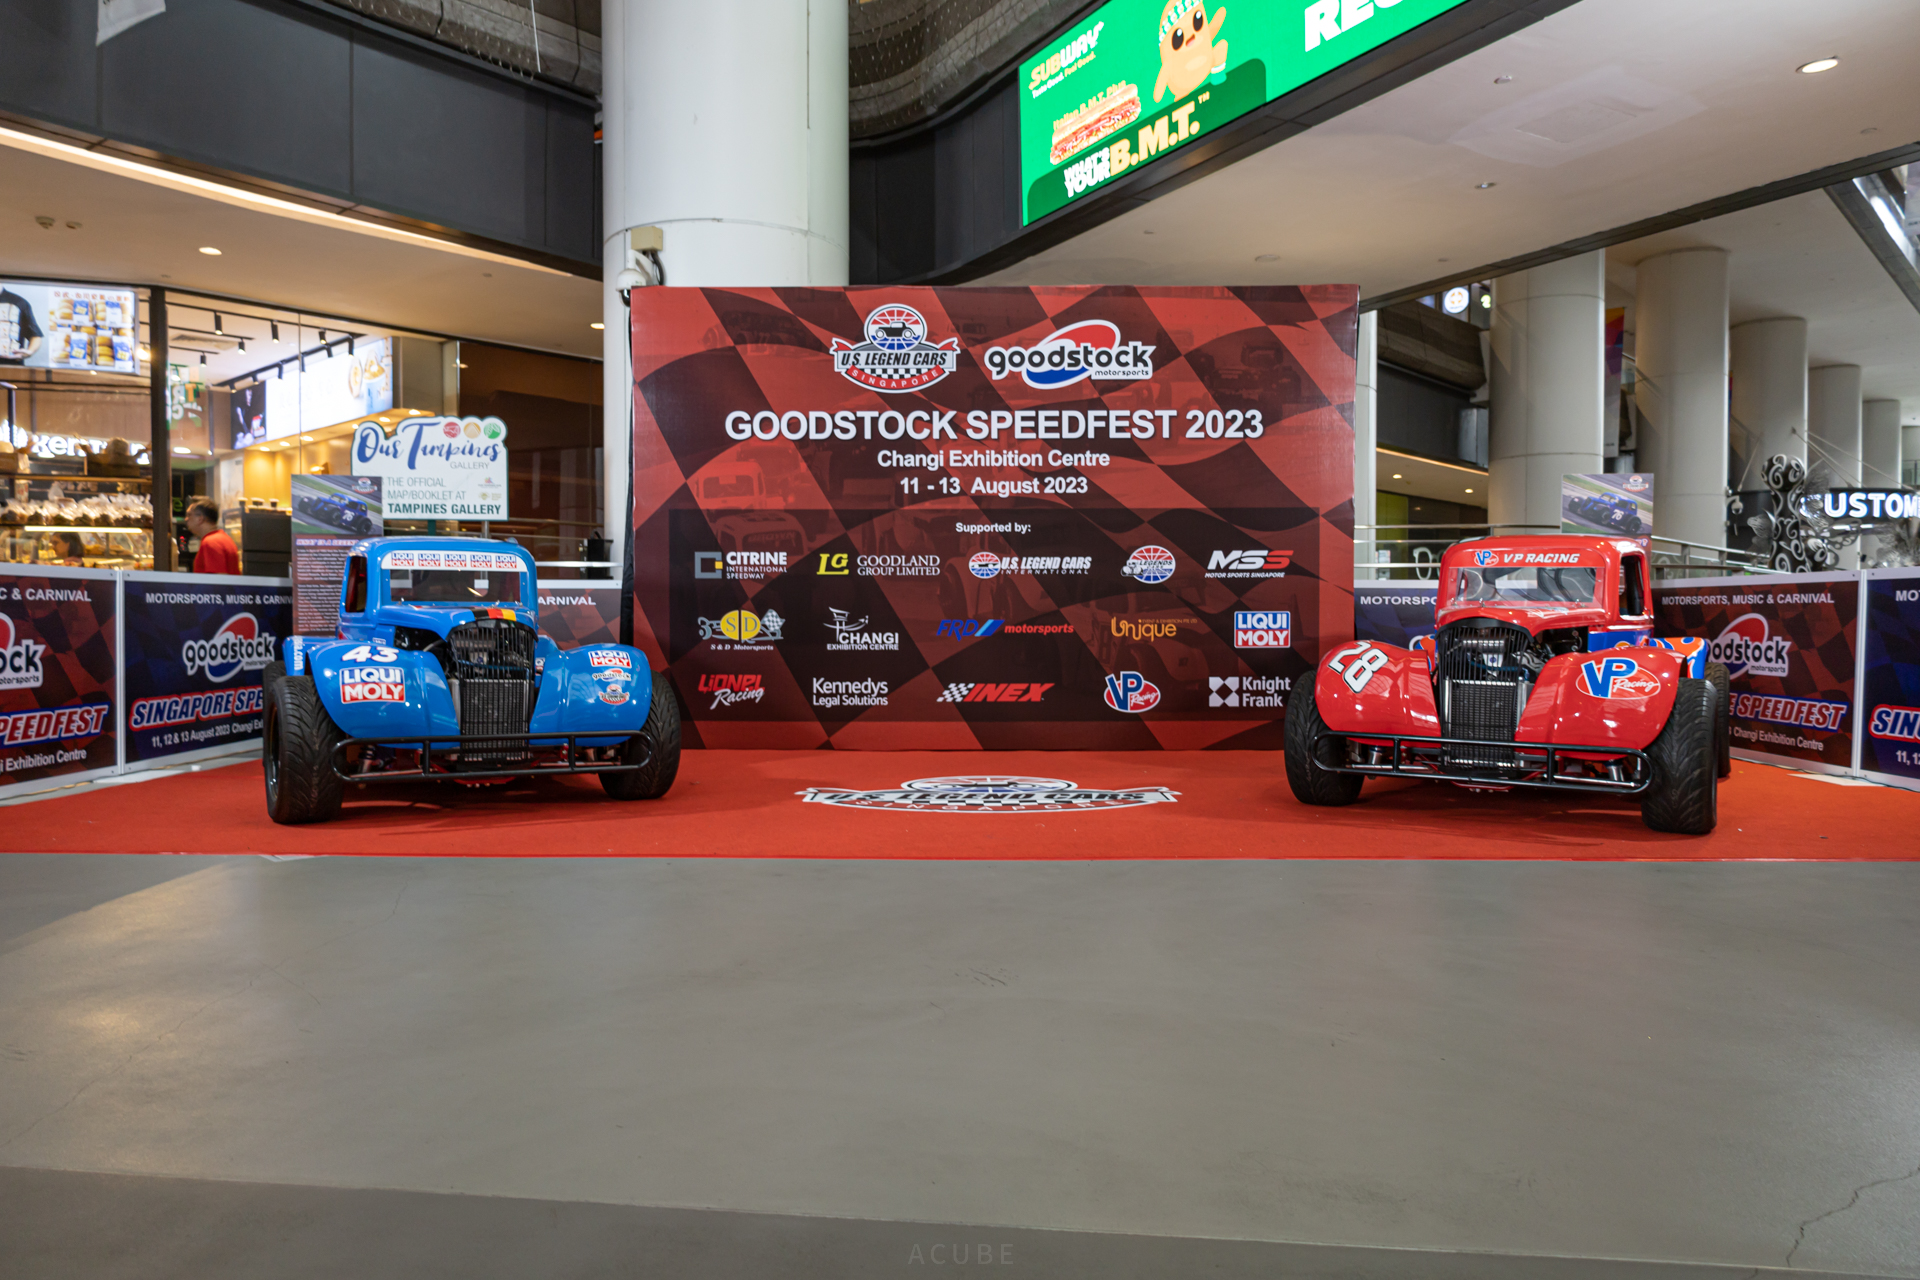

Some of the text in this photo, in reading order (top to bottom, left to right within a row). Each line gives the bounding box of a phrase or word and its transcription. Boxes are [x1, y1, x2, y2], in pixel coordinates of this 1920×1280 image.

[1305, 0, 1401, 52] RE
[1029, 21, 1104, 90] SUBWAY
[1064, 160, 1111, 198] YOUR
[1110, 101, 1200, 176] B.M.T.
[841, 352, 947, 366] U.S. LEGEND CARS
[988, 345, 1149, 376] goodstock
[851, 368, 940, 388] SINGAPORE
[1095, 370, 1149, 378] motorsports
[725, 410, 1264, 440] GOODSTOCK SPEEDFEST 2023
[450, 461, 490, 470] GALLERY
[877, 449, 1110, 472] Changi Exhibition Centre
[387, 477, 404, 487] THE
[407, 477, 446, 487] OFFICIAL
[900, 477, 1088, 498] 11 13 August 2023
[387, 490, 466, 500] MAP/BOOKLET AT
[387, 503, 502, 515] TAMPINES GALLERY
[1801, 492, 1920, 518] USTOM
[955, 522, 1032, 536] Supported by:
[726, 551, 788, 566] CITRINE
[857, 555, 941, 567] GOODLAND
[1001, 556, 1092, 569] U.S. LEGEND CARS
[1207, 550, 1294, 570] MSS
[1504, 553, 1524, 563] VP
[1525, 553, 1580, 563] RACING
[857, 567, 941, 576] GROUP LIMITED
[12, 588, 22, 600] &
[26, 588, 92, 602] CARNIVAL
[145, 592, 293, 605] MOTORSPORTS, MUSIC & CARNIV
[537, 596, 597, 606] ARNIVAL
[1360, 596, 1437, 605] MOTORSPO
[1662, 592, 1835, 606] MOTORSPORTS, MUSIC & CARNIVAL
[1004, 623, 1074, 635] motorsports
[1111, 616, 1177, 642] Unique
[1238, 613, 1287, 630] LIQUI
[839, 632, 899, 644] CHANGI
[1238, 631, 1288, 646] MOLY
[185, 636, 273, 671] goodstock
[342, 645, 399, 663] 43
[733, 644, 774, 652] Motorsports
[1705, 638, 1786, 664] odstock
[593, 657, 629, 666] MOLY
[1328, 640, 1388, 693] 28
[1751, 665, 1786, 673] motorsports
[0, 676, 40, 685] otorsports
[344, 668, 402, 683] LIQUI
[1581, 657, 1639, 698] VP
[344, 684, 403, 701] MOLY
[813, 677, 888, 698] Kennedys
[964, 683, 1054, 702] INEX
[1106, 671, 1144, 711] VP
[1242, 676, 1291, 693] Knight
[1613, 678, 1659, 692] Racing
[710, 687, 765, 710] Racing
[813, 695, 888, 708] Legal Solutions
[1131, 690, 1159, 706] Racing
[1242, 693, 1283, 708] Frank
[132, 688, 263, 727] SINGAPORE SPE
[1737, 694, 1847, 730] SPEEDFEST
[0, 704, 109, 746] PEEDFEST
[151, 736, 162, 748] 11,
[164, 734, 173, 746] 12
[181, 731, 189, 742] 13
[190, 728, 215, 741] August
[215, 724, 231, 736] 2023
[231, 721, 253, 734] Changi
[1734, 727, 1758, 742] Changi
[1759, 731, 1796, 747] Exhibition
[1797, 737, 1824, 751] Centre
[6, 752, 55, 772] Exhibition
[56, 748, 87, 766] Centre
